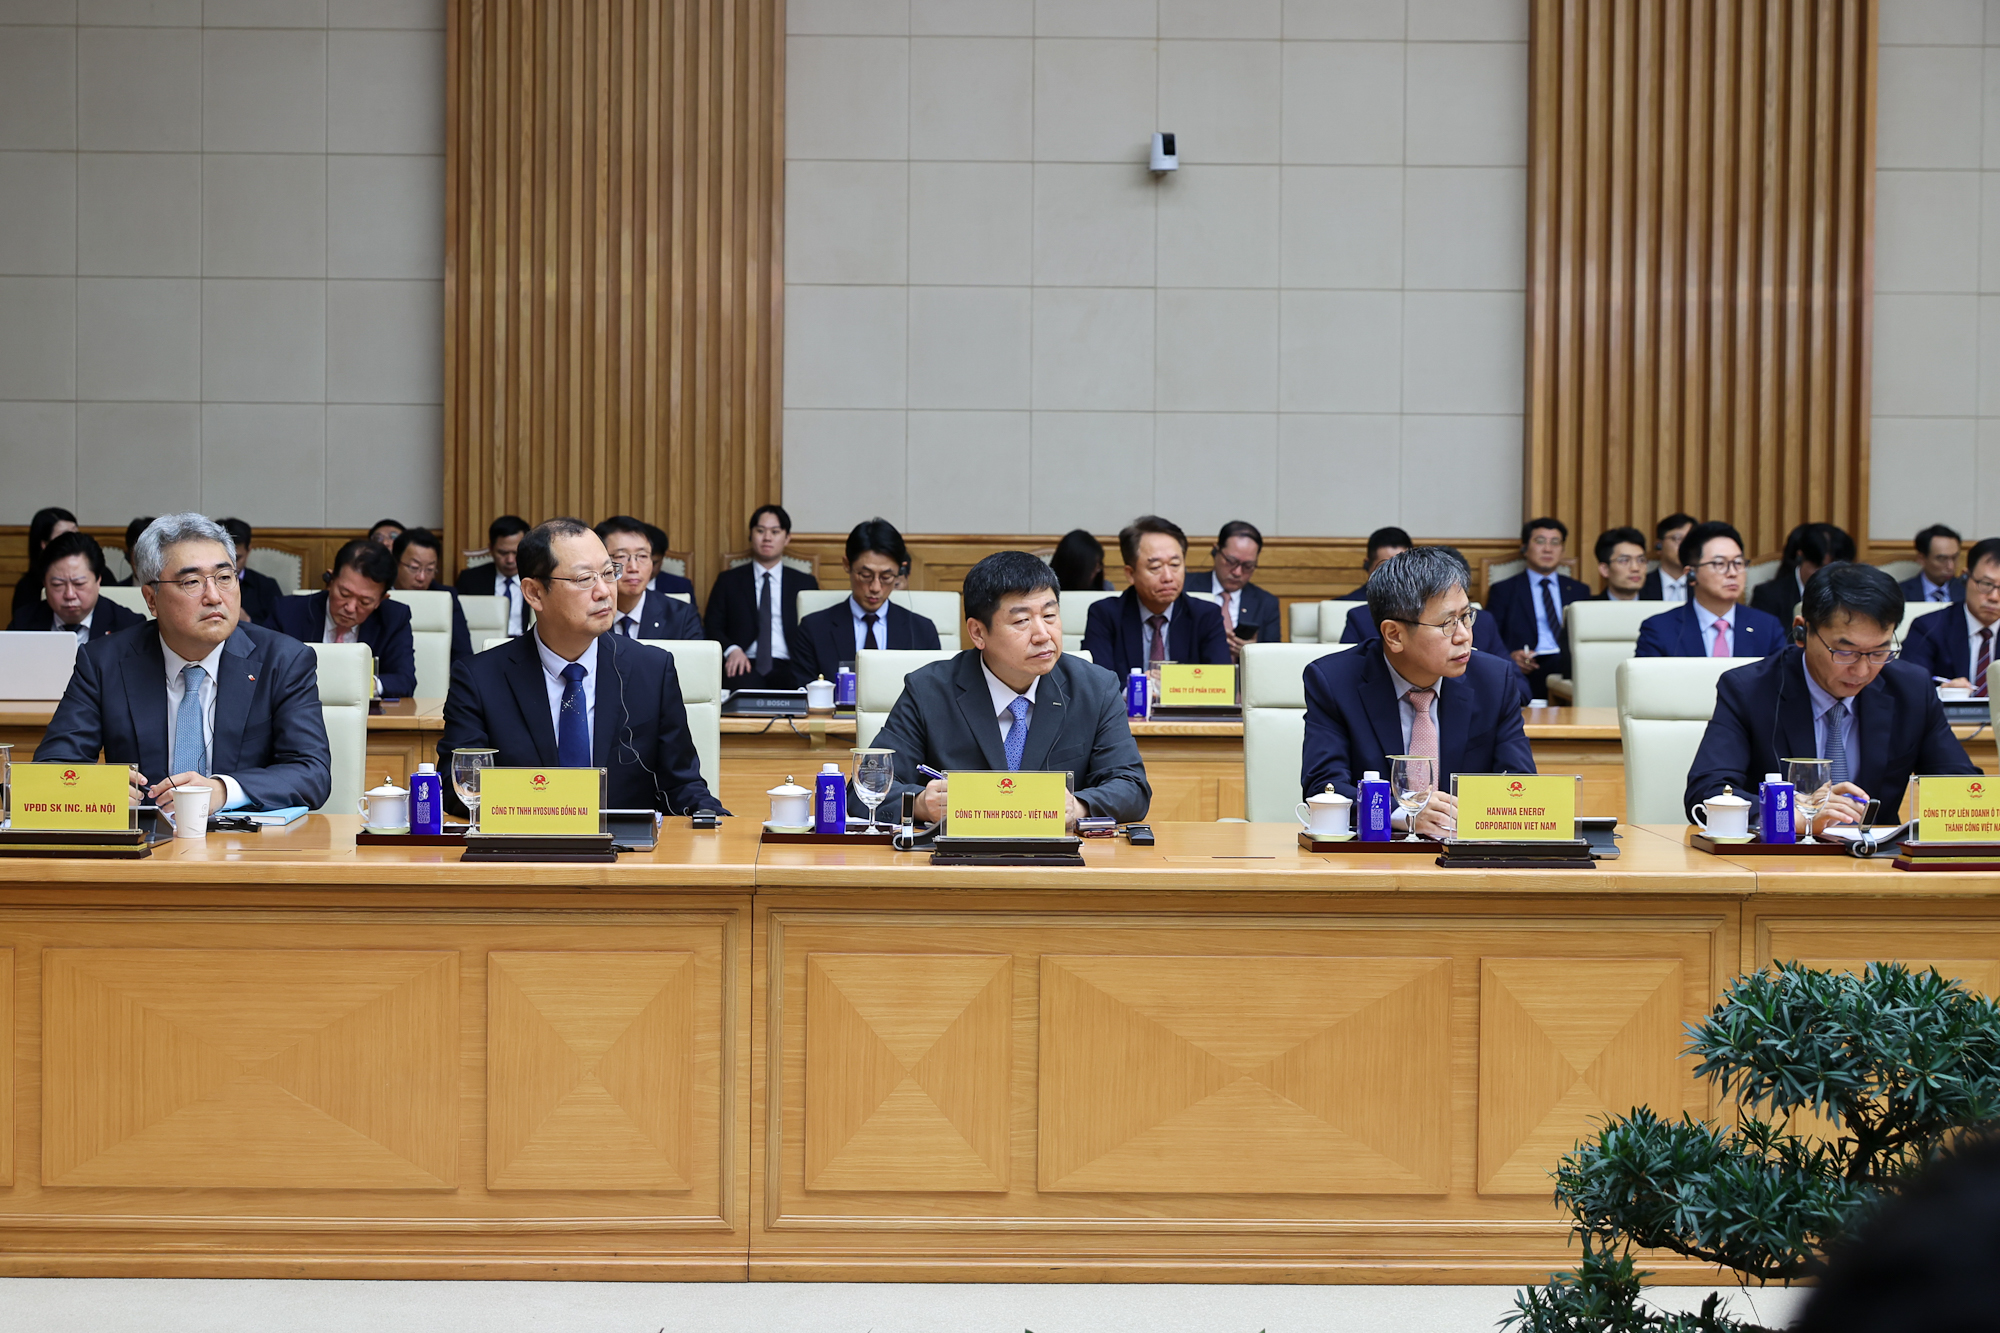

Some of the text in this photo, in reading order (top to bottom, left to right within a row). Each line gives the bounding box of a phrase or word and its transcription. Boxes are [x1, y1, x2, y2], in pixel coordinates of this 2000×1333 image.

[24, 802, 116, 815] VPĐD SK INC. HÀ NỘI
[492, 805, 507, 815] CÔNG
[508, 806, 516, 815] TY
[516, 806, 532, 815] TNHH
[533, 806, 560, 816] HYOSUNG
[577, 807, 588, 816] NAI
[955, 808, 973, 819] CÔNG
[974, 810, 982, 819] TY
[983, 810, 1000, 819] TNHH
[1001, 810, 1023, 819] POSCO
[1028, 808, 1042, 821] VIỆT
[1043, 811, 1058, 819] NAM
[1486, 807, 1546, 816] HANWHA ENERGY
[1923, 807, 1939, 818] CÔNG
[1940, 809, 1947, 818] TY
[1948, 809, 1956, 818] CP
[1957, 806, 1970, 818] LIÊN
[1971, 809, 1990, 818] DOANH
[1475, 821, 1557, 830] CORPORATION VIET NAM
[1945, 821, 1964, 832] THÀNH
[1965, 821, 1980, 832] CÔNG
[1981, 821, 1993, 834] VIỆT
